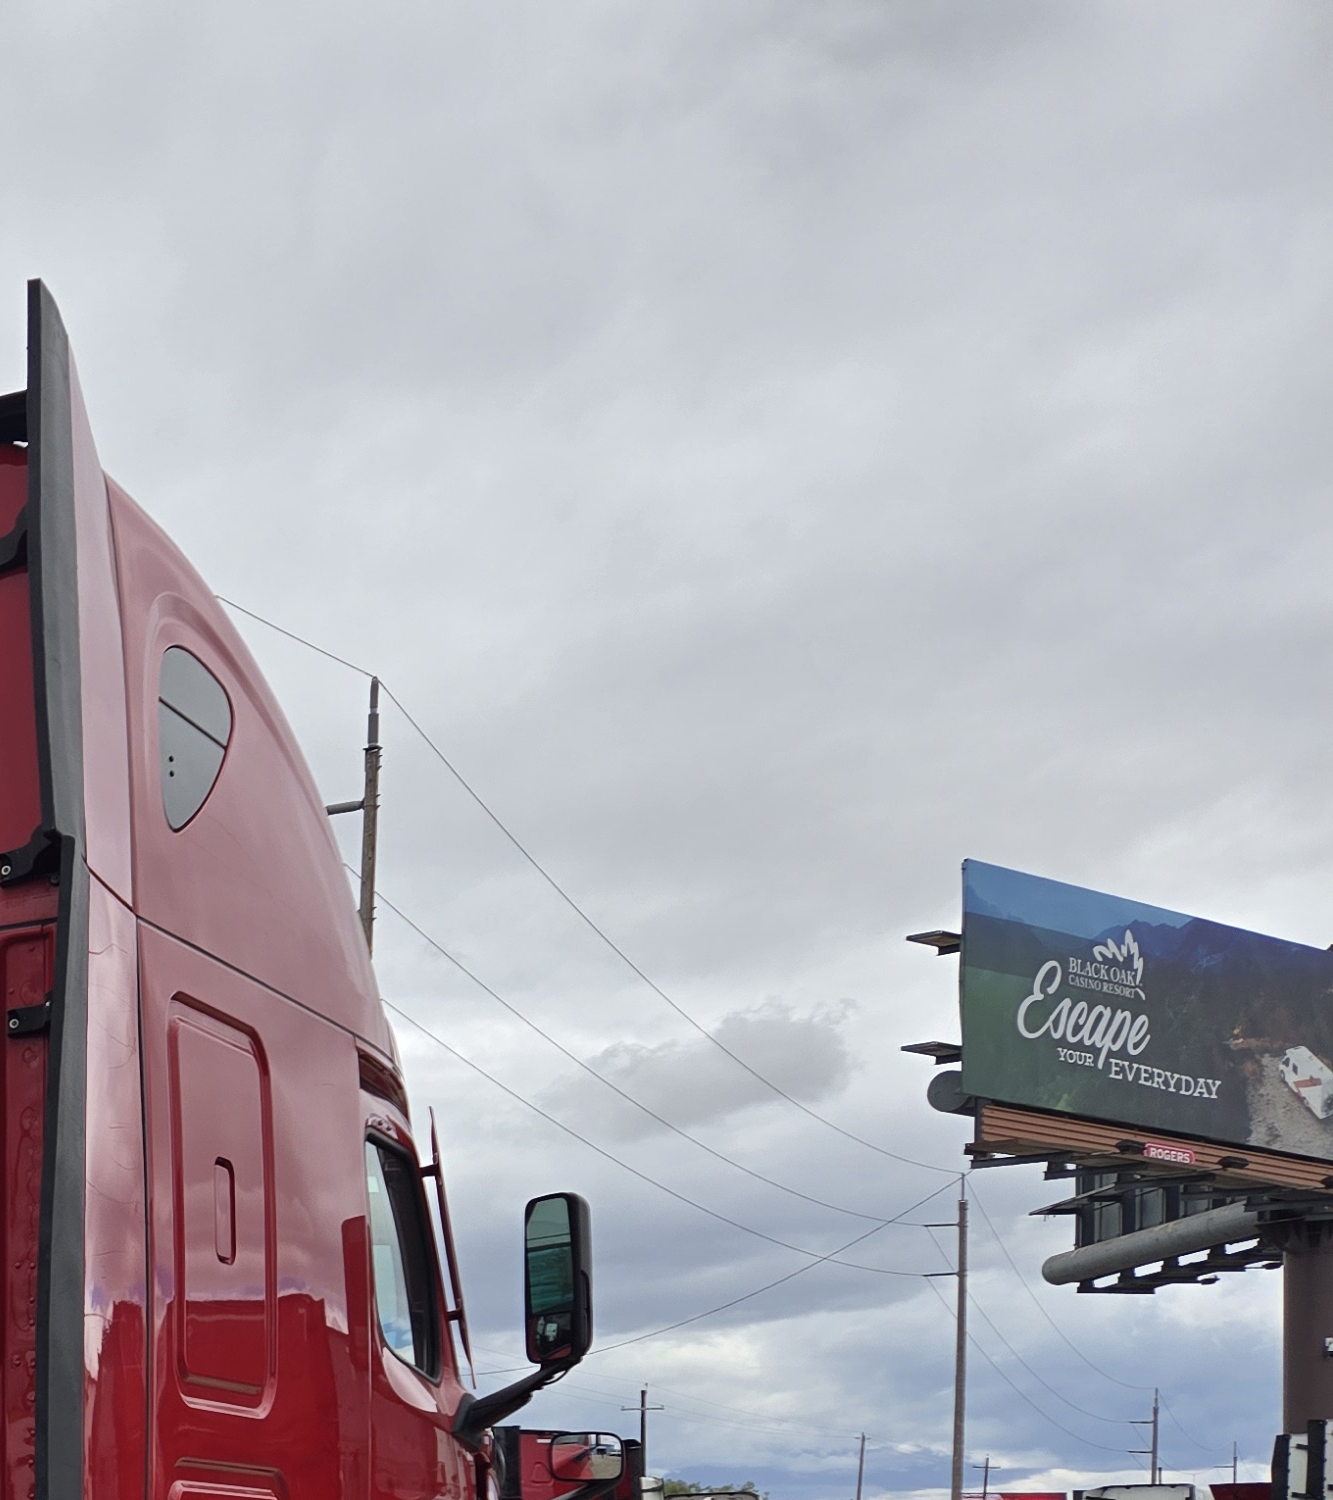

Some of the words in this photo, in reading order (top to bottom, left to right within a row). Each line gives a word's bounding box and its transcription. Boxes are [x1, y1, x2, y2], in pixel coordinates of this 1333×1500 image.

[1069, 957, 1109, 980] BLACK
[1110, 967, 1136, 986] OAK
[1068, 974, 1101, 991] CASINO
[1102, 982, 1136, 999] RESORT
[1017, 960, 1151, 1070] Escape
[1057, 1047, 1094, 1067] YOUR
[1108, 1058, 1222, 1100] EVERYDAY
[1149, 1146, 1191, 1164] ROGERS
